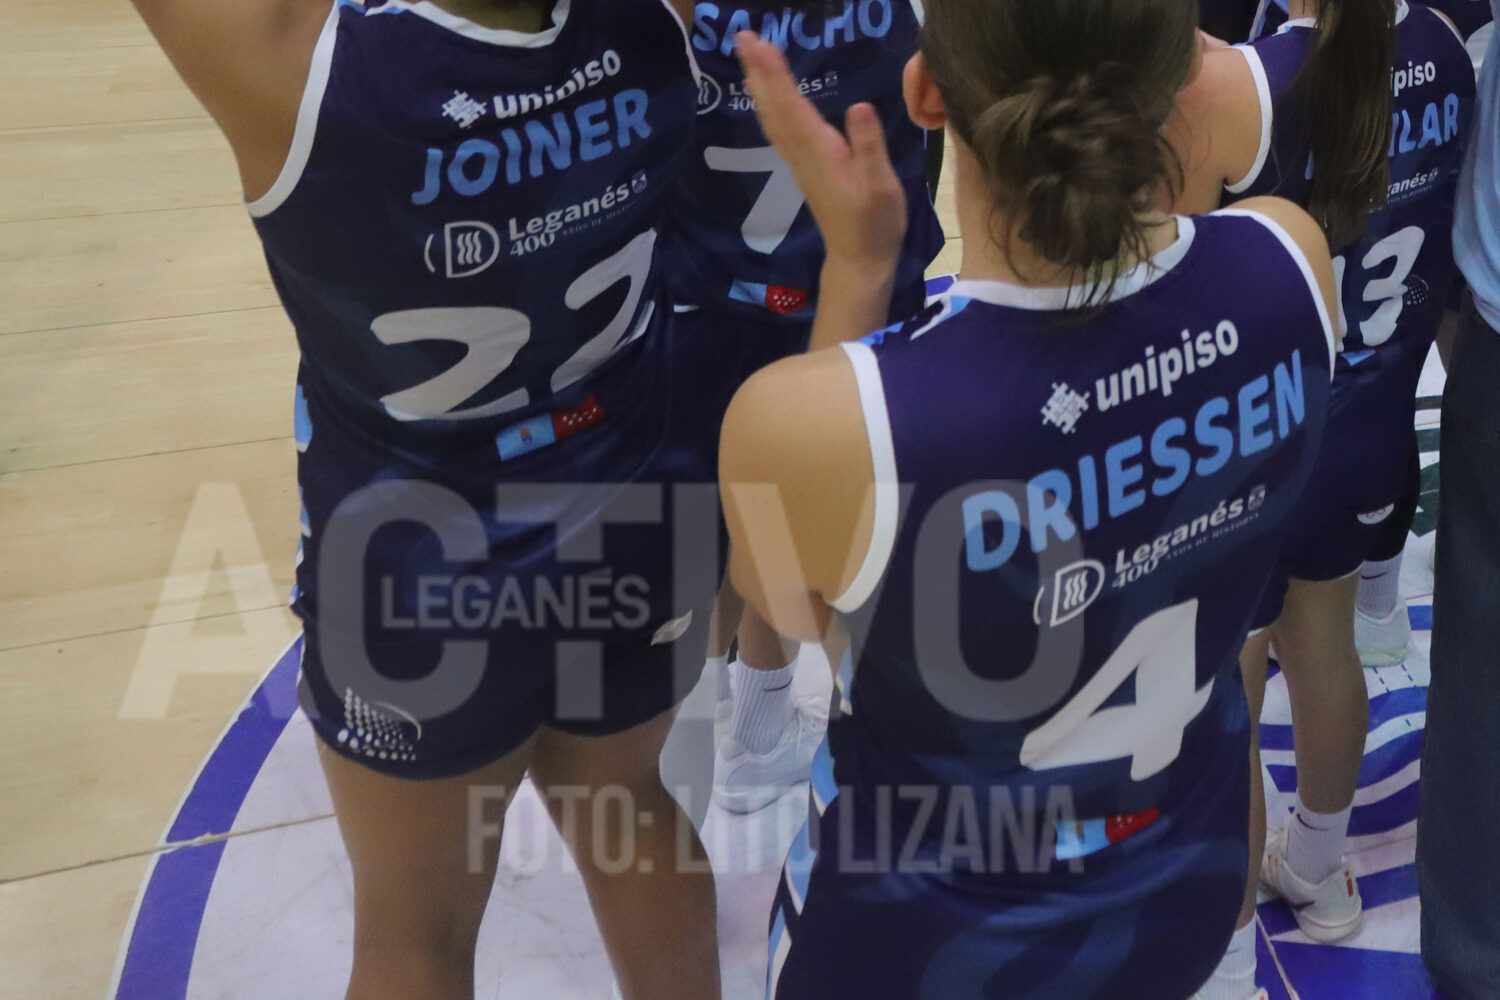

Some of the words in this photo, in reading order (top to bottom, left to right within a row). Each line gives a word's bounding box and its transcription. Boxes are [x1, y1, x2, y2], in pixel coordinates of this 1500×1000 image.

[492, 49, 622, 120] unipiso
[411, 87, 653, 206] JOINER
[508, 182, 630, 242] Leganés
[509, 231, 556, 257] 400
[703, 145, 806, 256] 7
[369, 228, 658, 422] 22
[1094, 319, 1239, 412] unipiso
[961, 348, 1306, 573] DRIESSEN
[1112, 557, 1159, 589] 400
[1114, 498, 1244, 574] Leganés
[1018, 597, 1215, 783] 4
